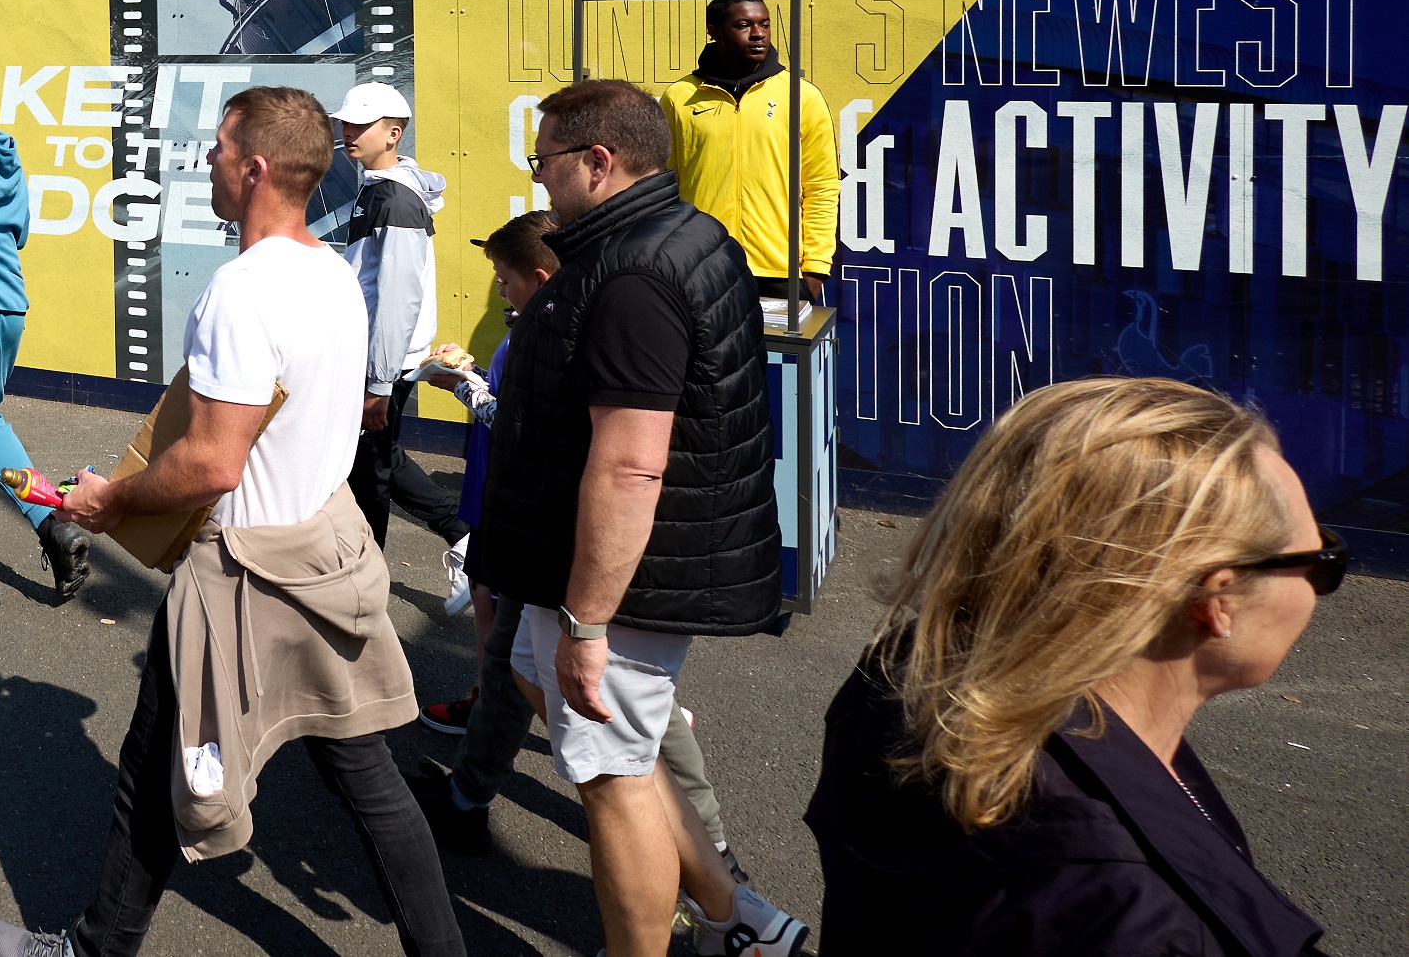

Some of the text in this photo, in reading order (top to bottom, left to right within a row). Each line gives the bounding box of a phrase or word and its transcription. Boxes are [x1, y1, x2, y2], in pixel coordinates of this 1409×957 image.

[150, 65, 253, 131] IT
[46, 135, 114, 170] TO
[27, 174, 228, 247] DGE
[839, 98, 1408, 282] & ACTIVITY
[842, 264, 1054, 431] TION
